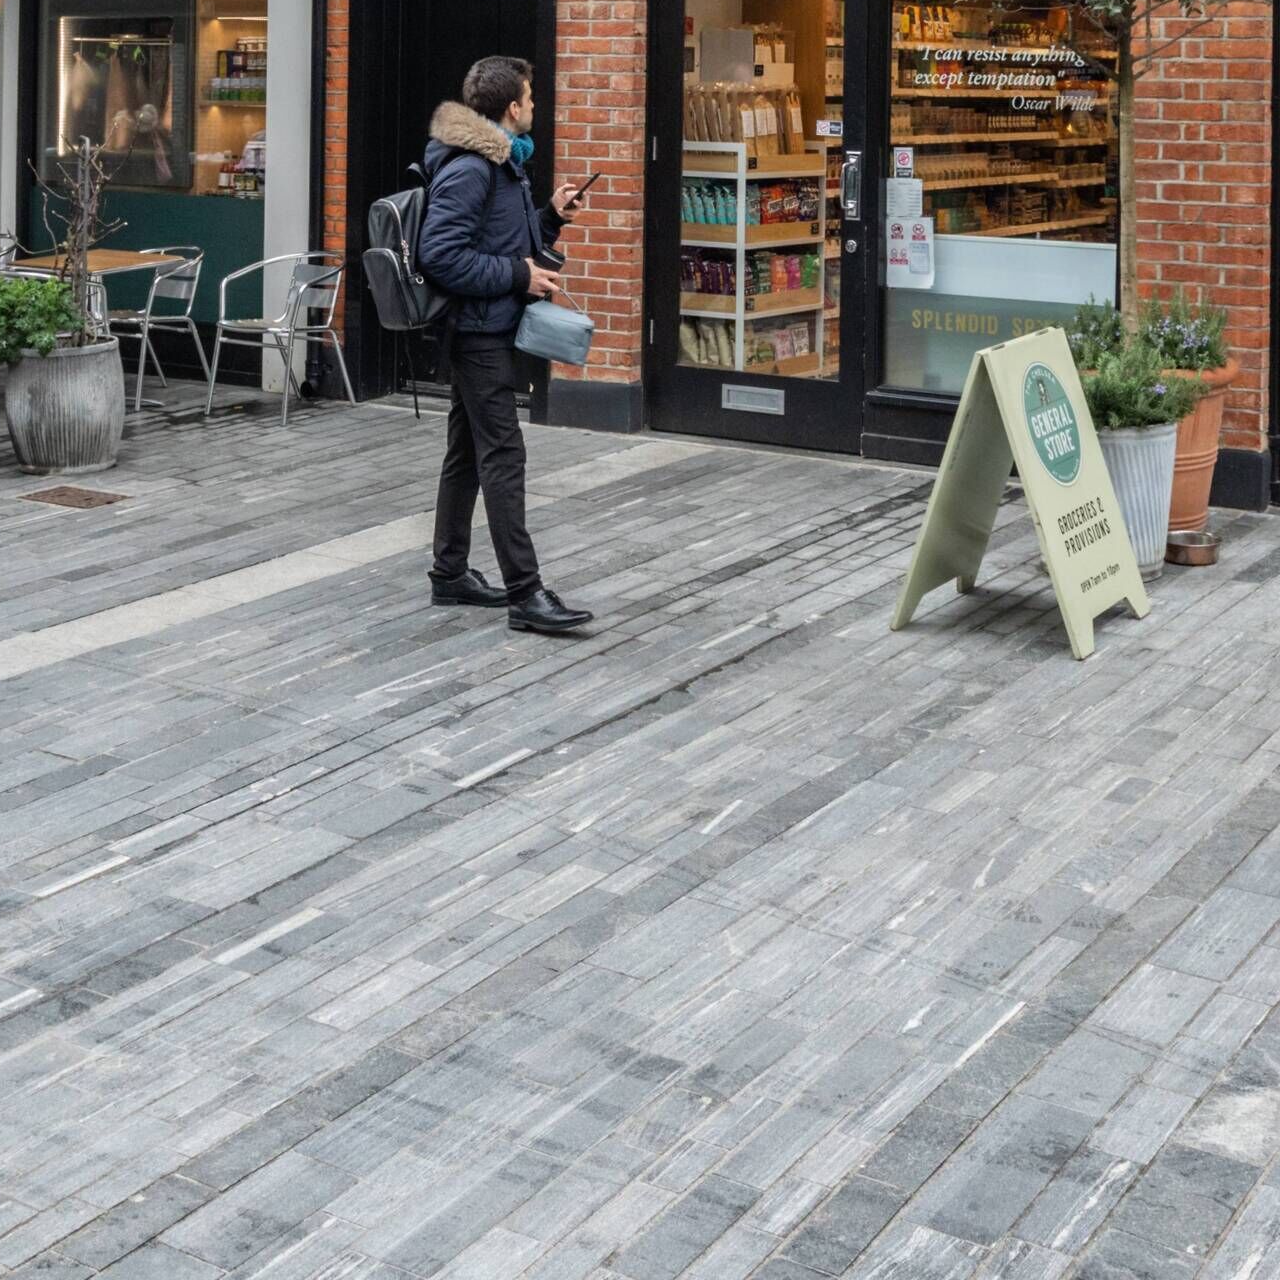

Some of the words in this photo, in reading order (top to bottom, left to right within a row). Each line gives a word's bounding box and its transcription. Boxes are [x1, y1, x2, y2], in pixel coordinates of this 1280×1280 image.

[934, 49, 963, 61] can
[967, 45, 1007, 62] resist
[914, 71, 964, 90] except
[1011, 94, 1052, 111] Oscar
[1054, 94, 1096, 112] Wilde
[911, 308, 999, 337] SPLENDID
[1030, 403, 1074, 439] GENERAL
[1044, 428, 1076, 461] STORE
[1057, 500, 1098, 536] GROCERIES
[1064, 517, 1111, 558] PROVISIONS
